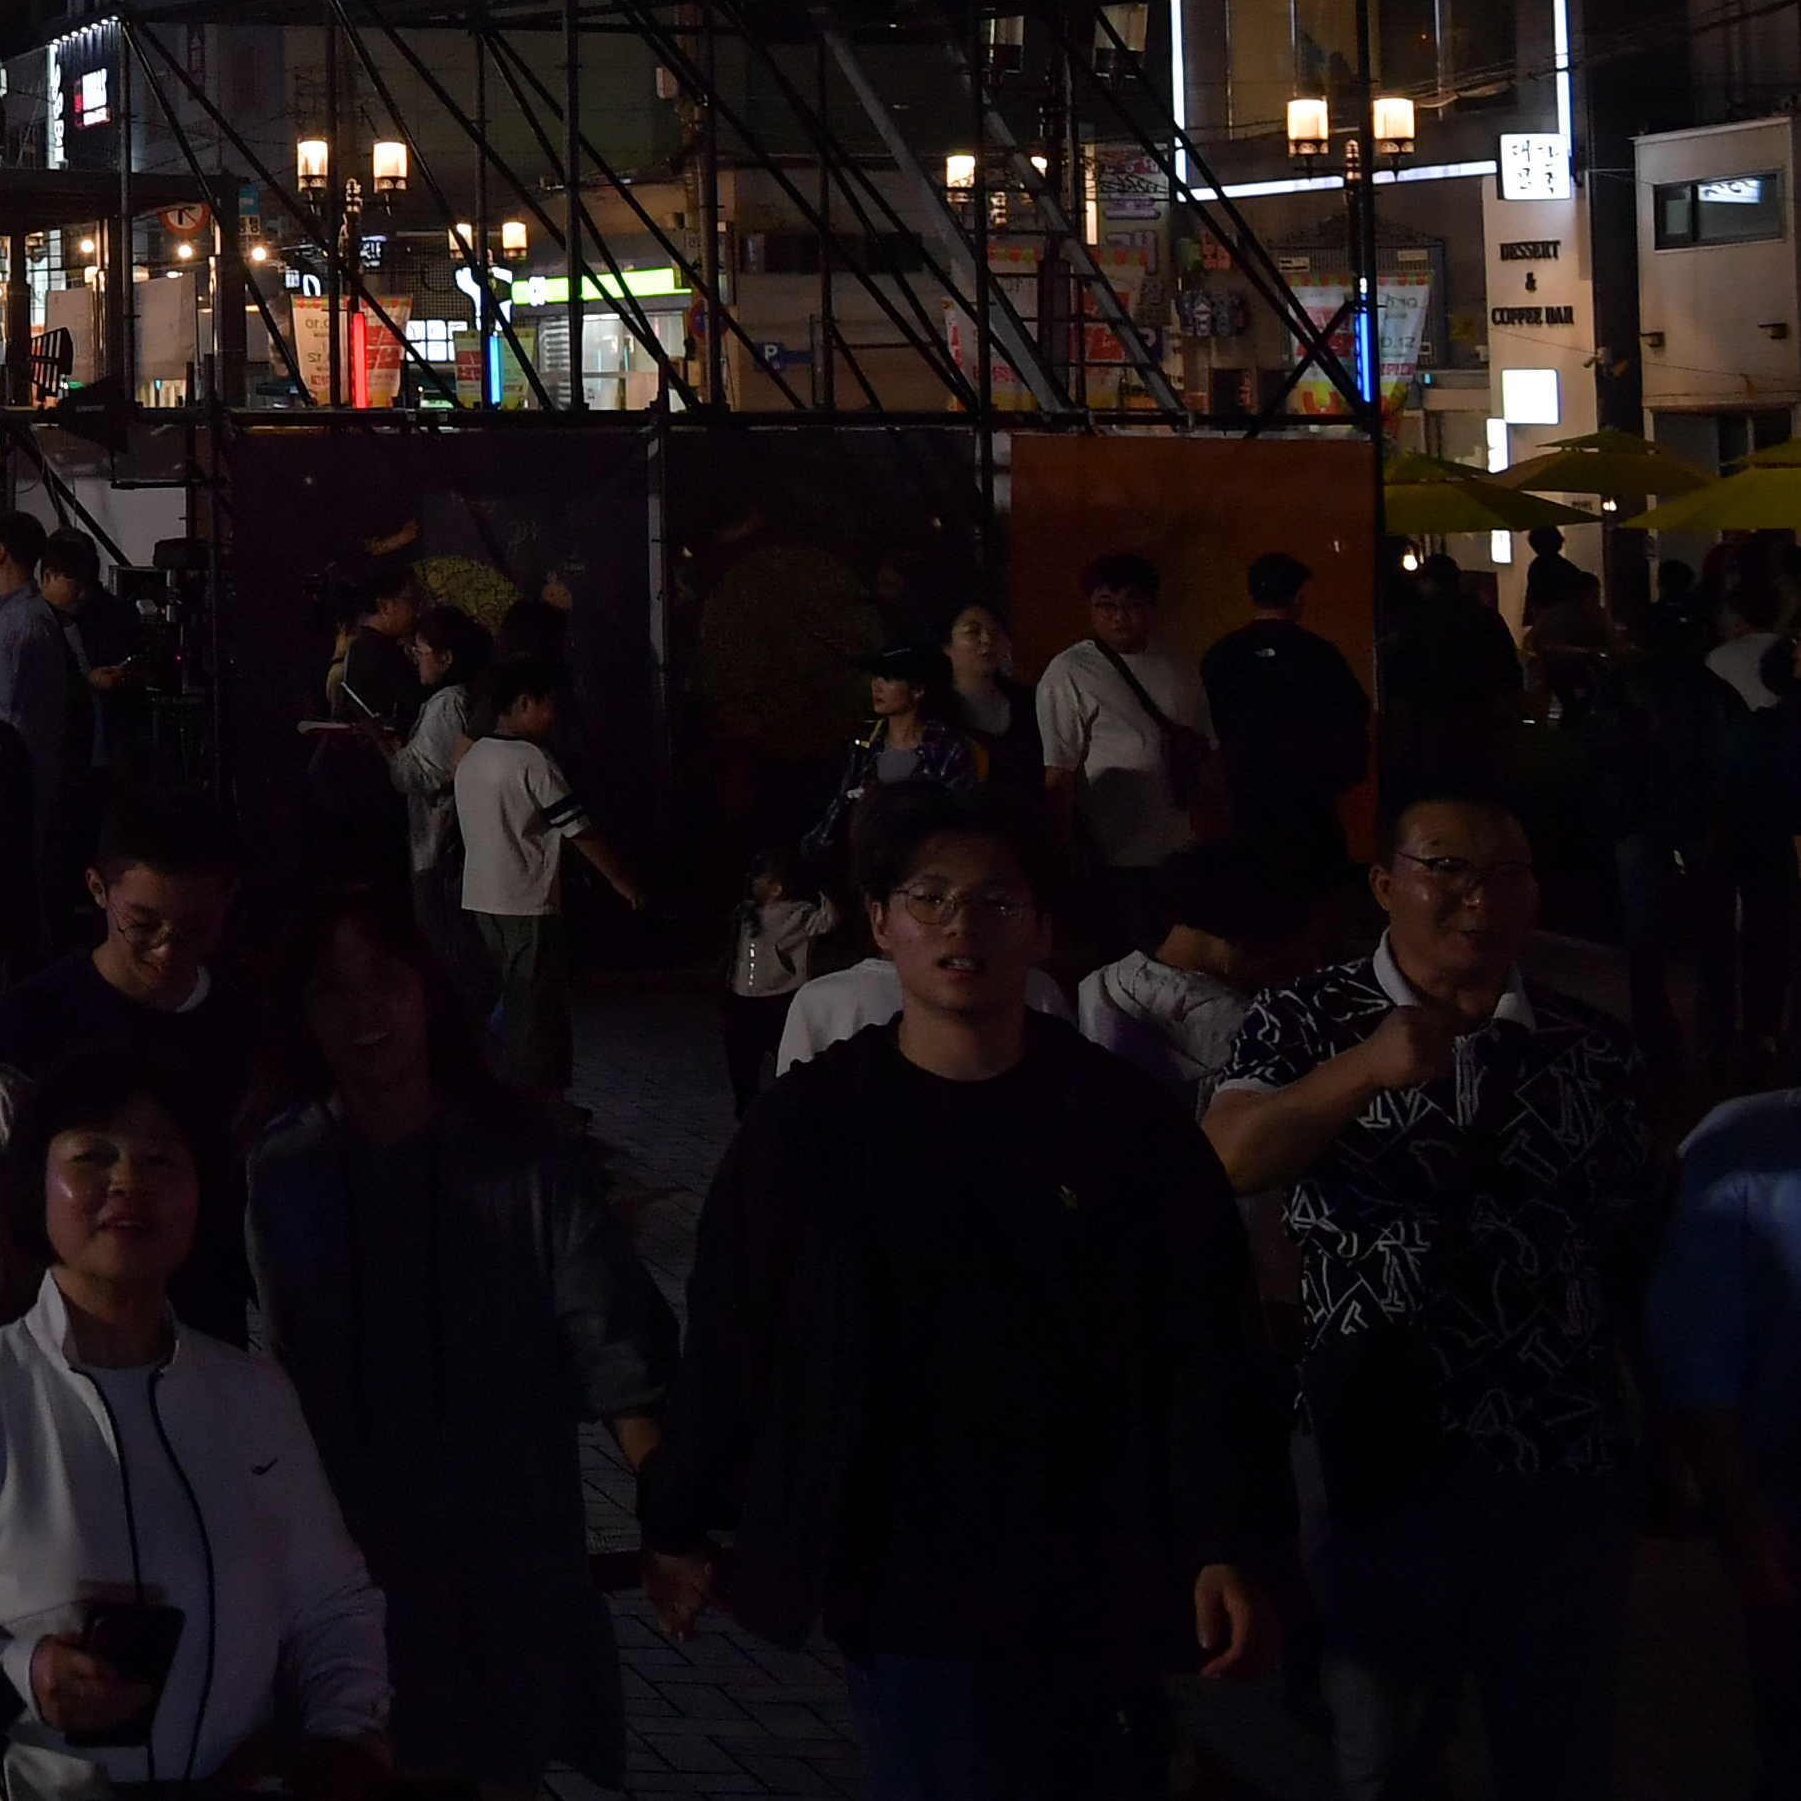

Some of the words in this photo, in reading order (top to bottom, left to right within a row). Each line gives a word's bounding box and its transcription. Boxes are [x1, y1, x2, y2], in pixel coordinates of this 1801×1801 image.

[1500, 240, 1561, 261] DESSERT
[1525, 271, 1537, 293] &
[1540, 305, 1570, 326] BAR
